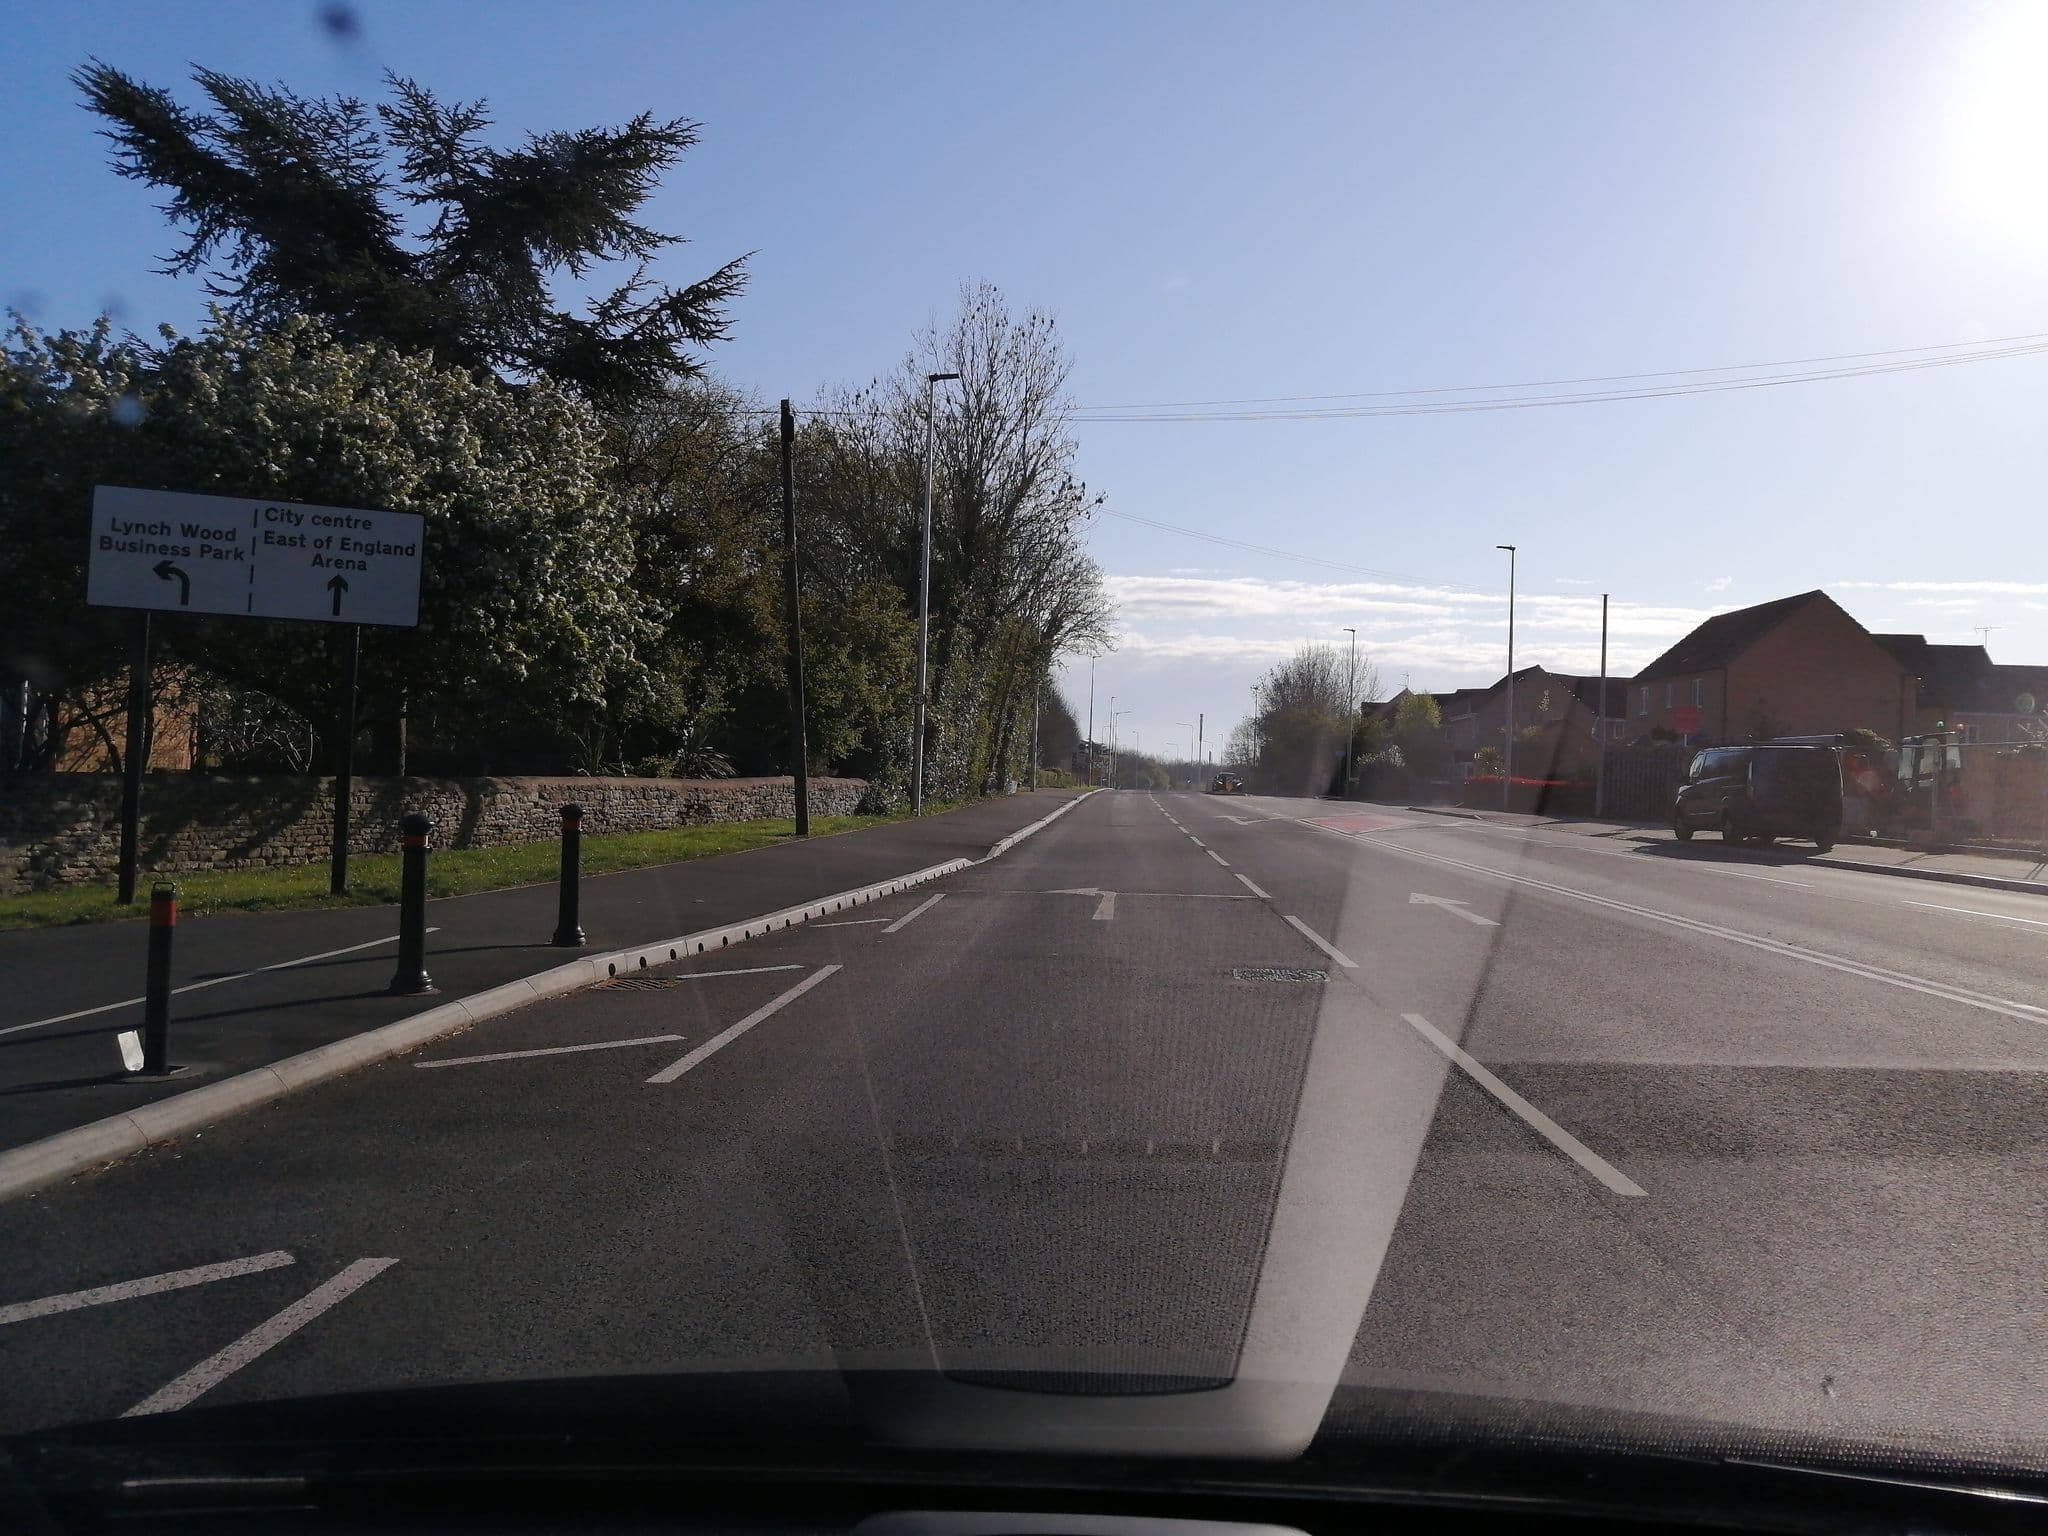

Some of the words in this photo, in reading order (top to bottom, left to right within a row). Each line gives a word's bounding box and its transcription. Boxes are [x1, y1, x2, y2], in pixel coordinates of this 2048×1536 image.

[110, 517, 171, 538] Lynch
[180, 522, 237, 542] Wood
[264, 507, 305, 527] City
[311, 512, 373, 531] centre
[99, 535, 191, 557] Business
[199, 544, 246, 562] Park
[263, 530, 307, 549] East
[313, 535, 334, 551] of
[340, 537, 416, 558] England
[311, 553, 368, 572] Arena
